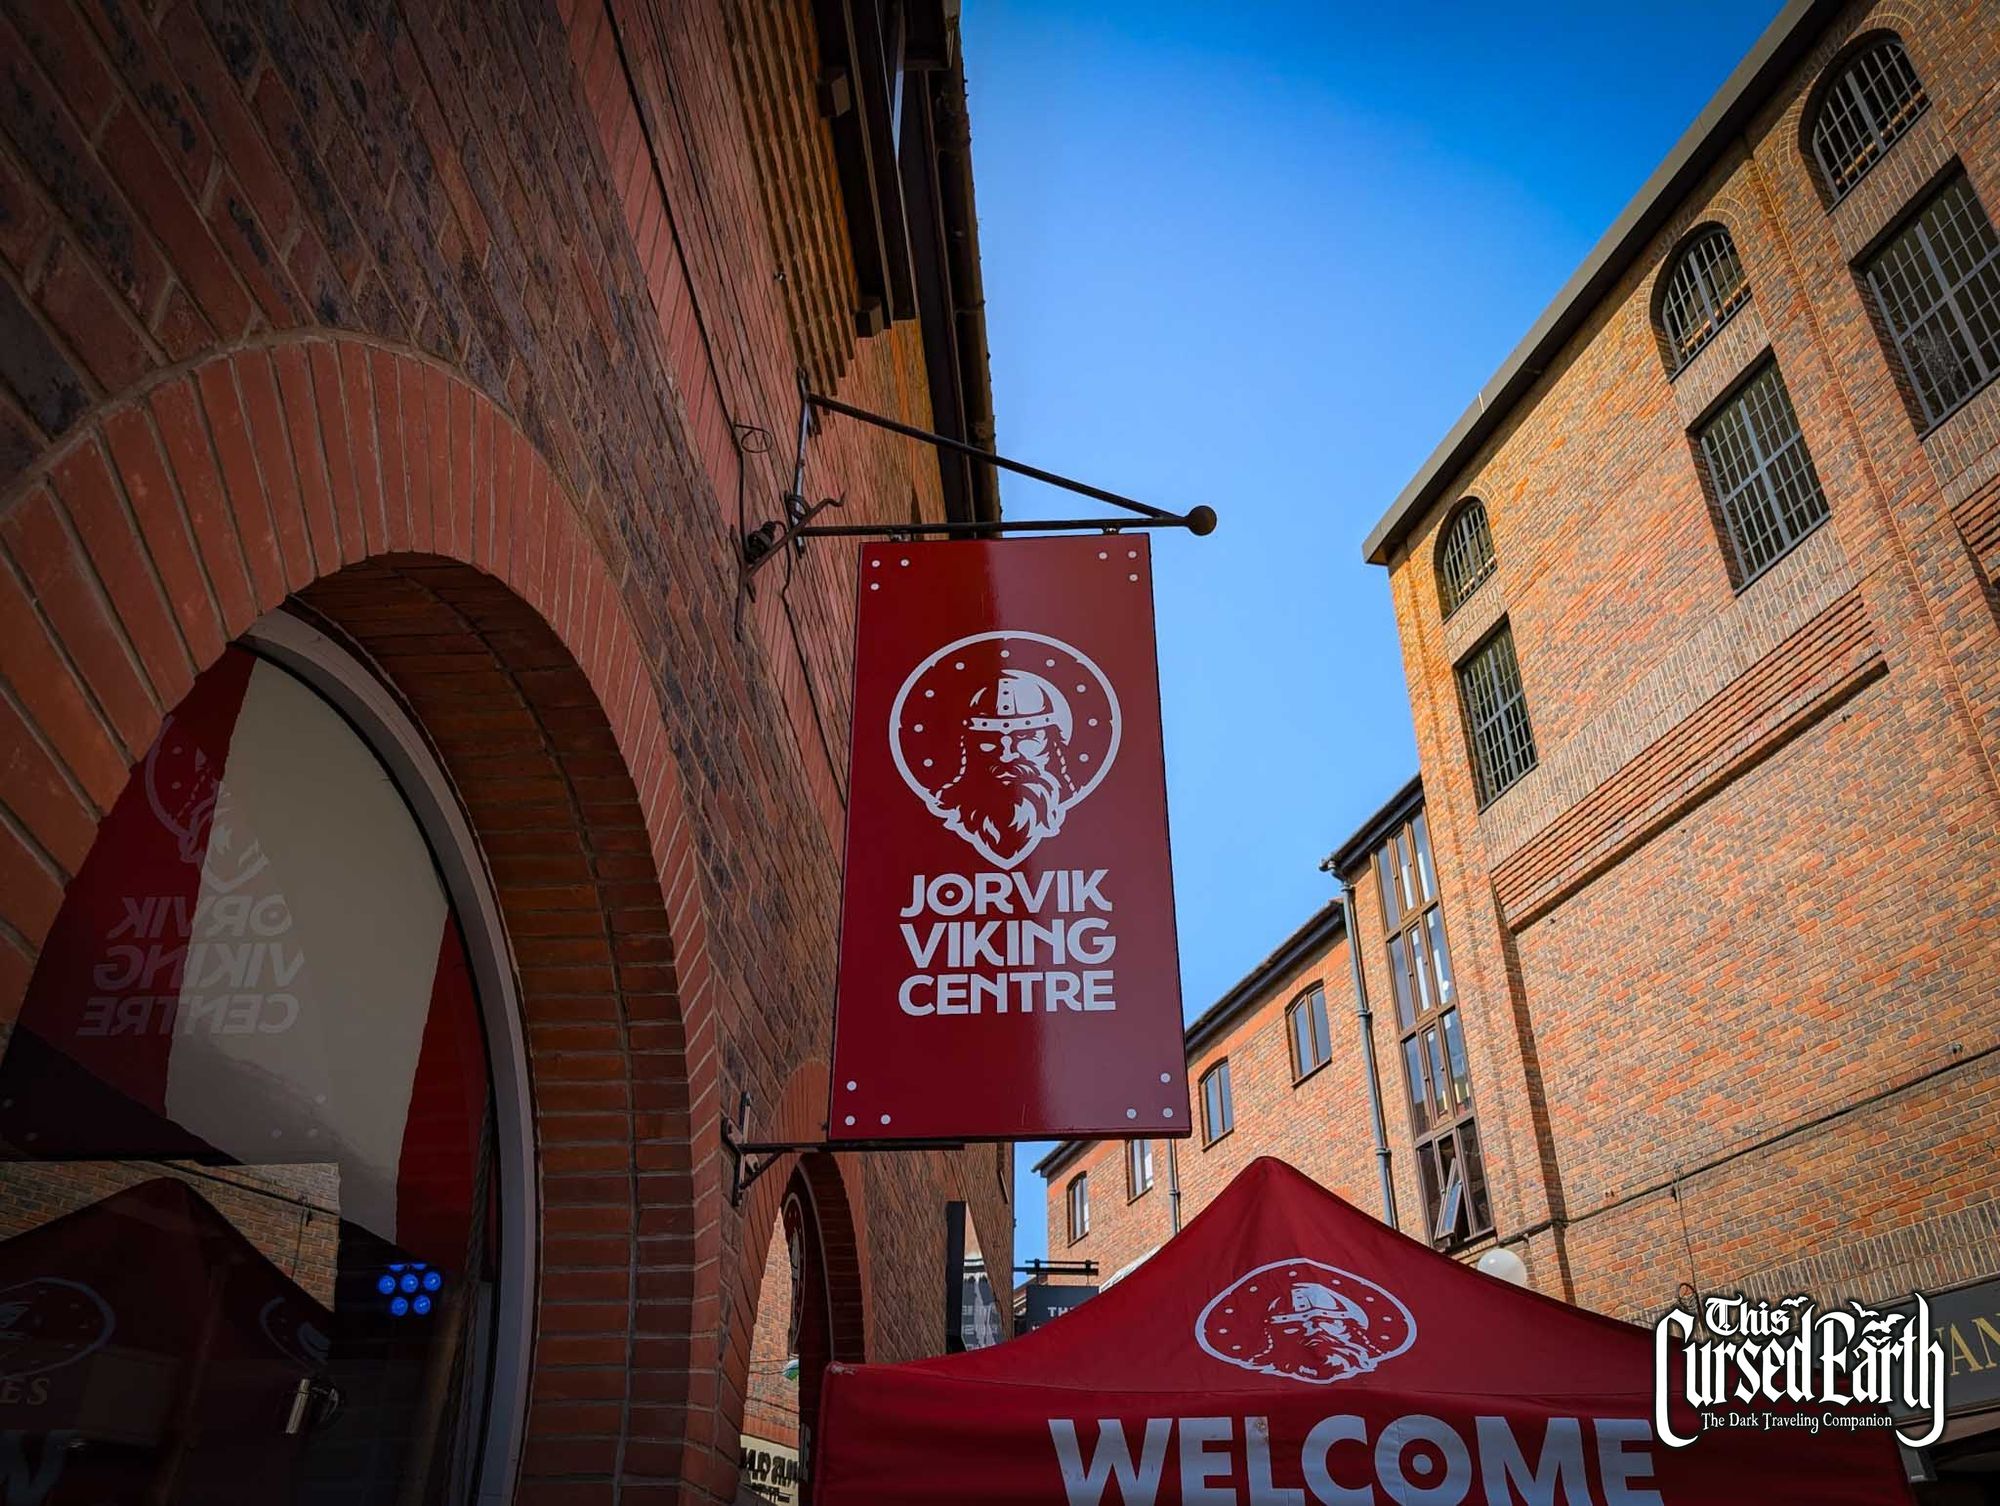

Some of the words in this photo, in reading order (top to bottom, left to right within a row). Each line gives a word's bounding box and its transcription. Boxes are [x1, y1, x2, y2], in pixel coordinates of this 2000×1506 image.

[900, 869, 1112, 917] JORVIK
[900, 918, 1116, 968] VIKING
[898, 970, 1116, 1016] CENTRE
[1047, 1306, 1075, 1317] TH
[1048, 1414, 1665, 1506] WELCOME
